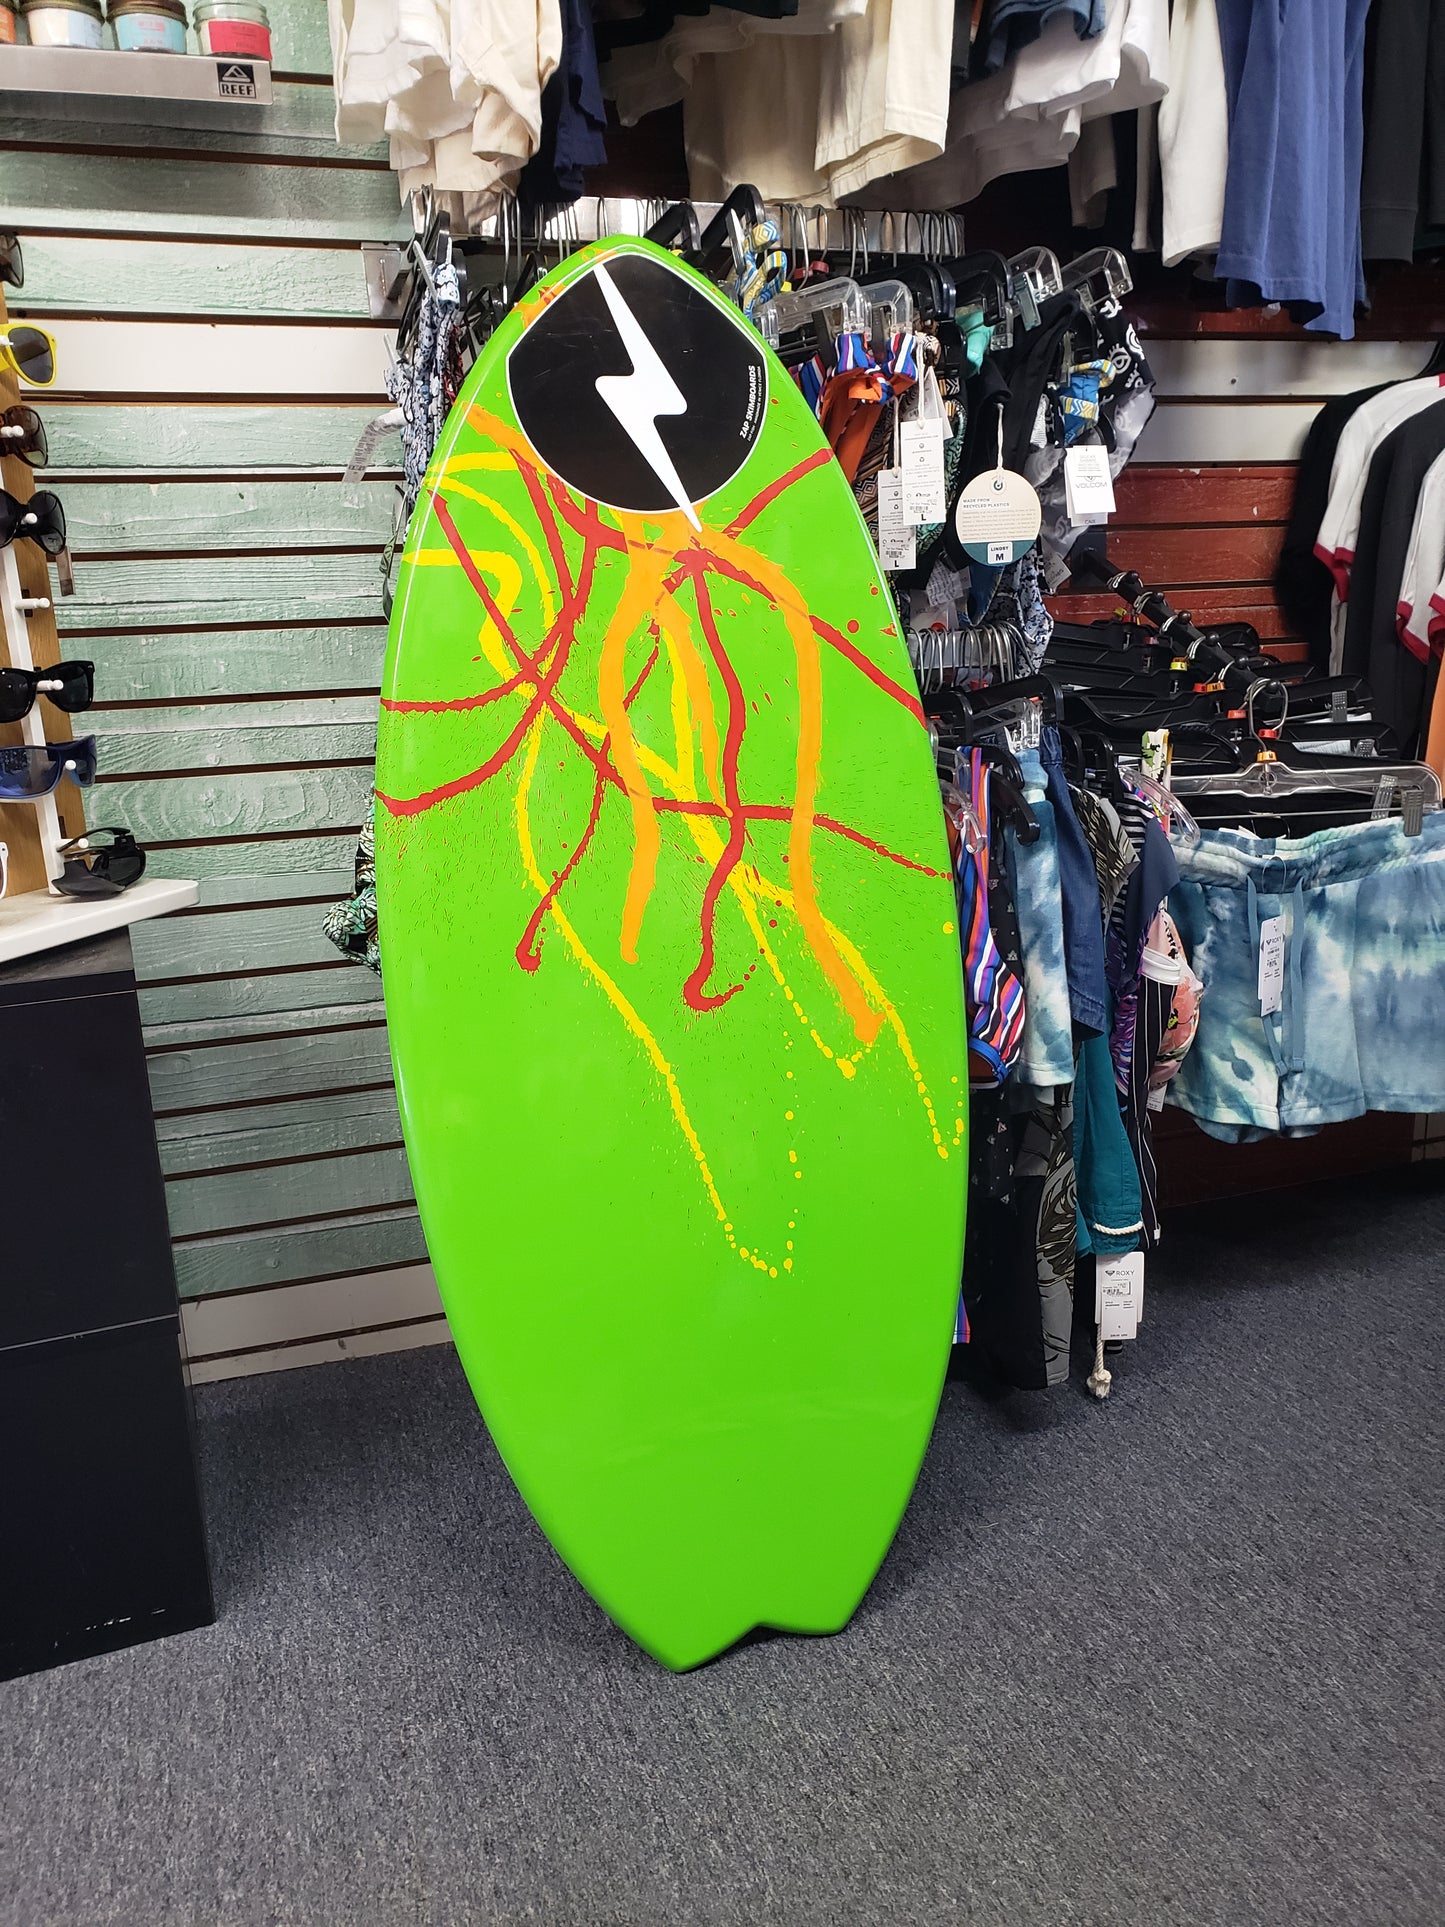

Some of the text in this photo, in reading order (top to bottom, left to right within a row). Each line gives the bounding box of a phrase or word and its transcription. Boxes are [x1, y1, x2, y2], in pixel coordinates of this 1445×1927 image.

[221, 83, 253, 96] REEF
[740, 365, 756, 438] ZAP SKIMBOARDS
[995, 553, 1004, 561] M
